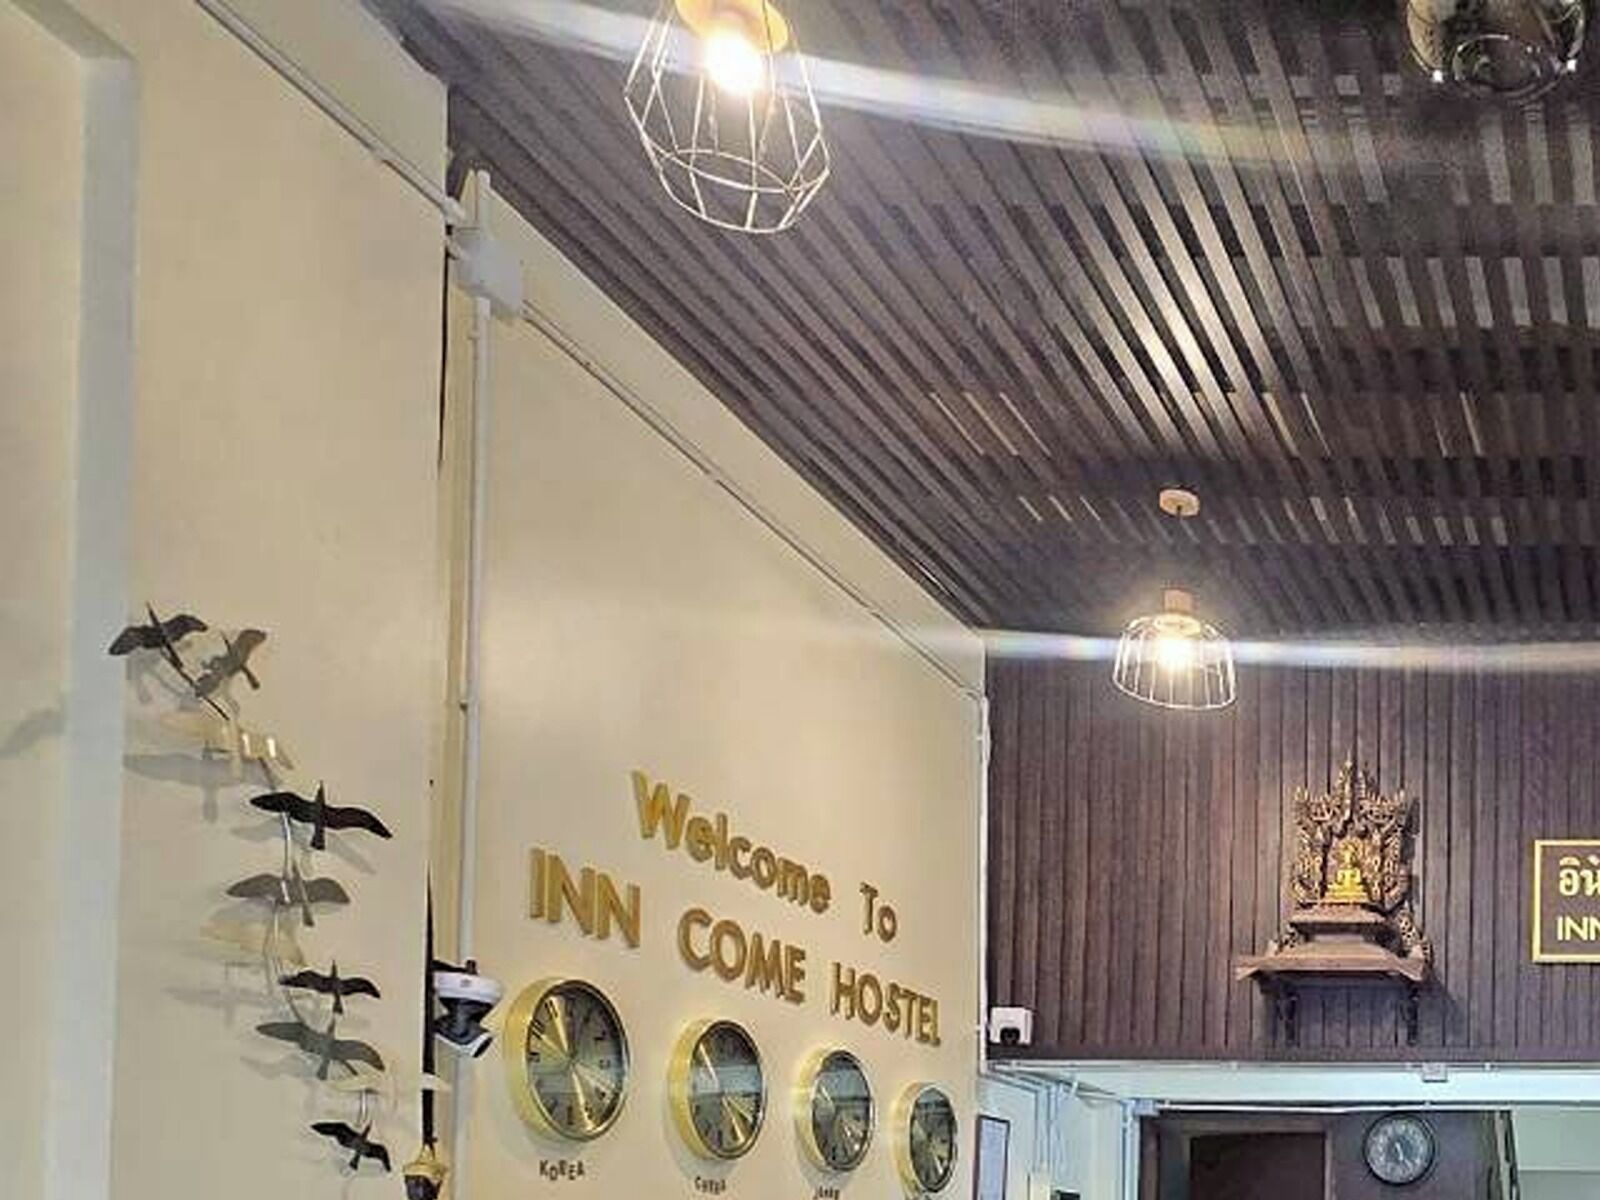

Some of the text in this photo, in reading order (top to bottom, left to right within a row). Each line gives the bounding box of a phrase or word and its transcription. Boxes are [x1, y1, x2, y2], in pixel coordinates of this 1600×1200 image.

[631, 769, 898, 943] Welcome To
[529, 847, 942, 1047] INN COME HOSTEL
[539, 1159, 586, 1182] KOREA
